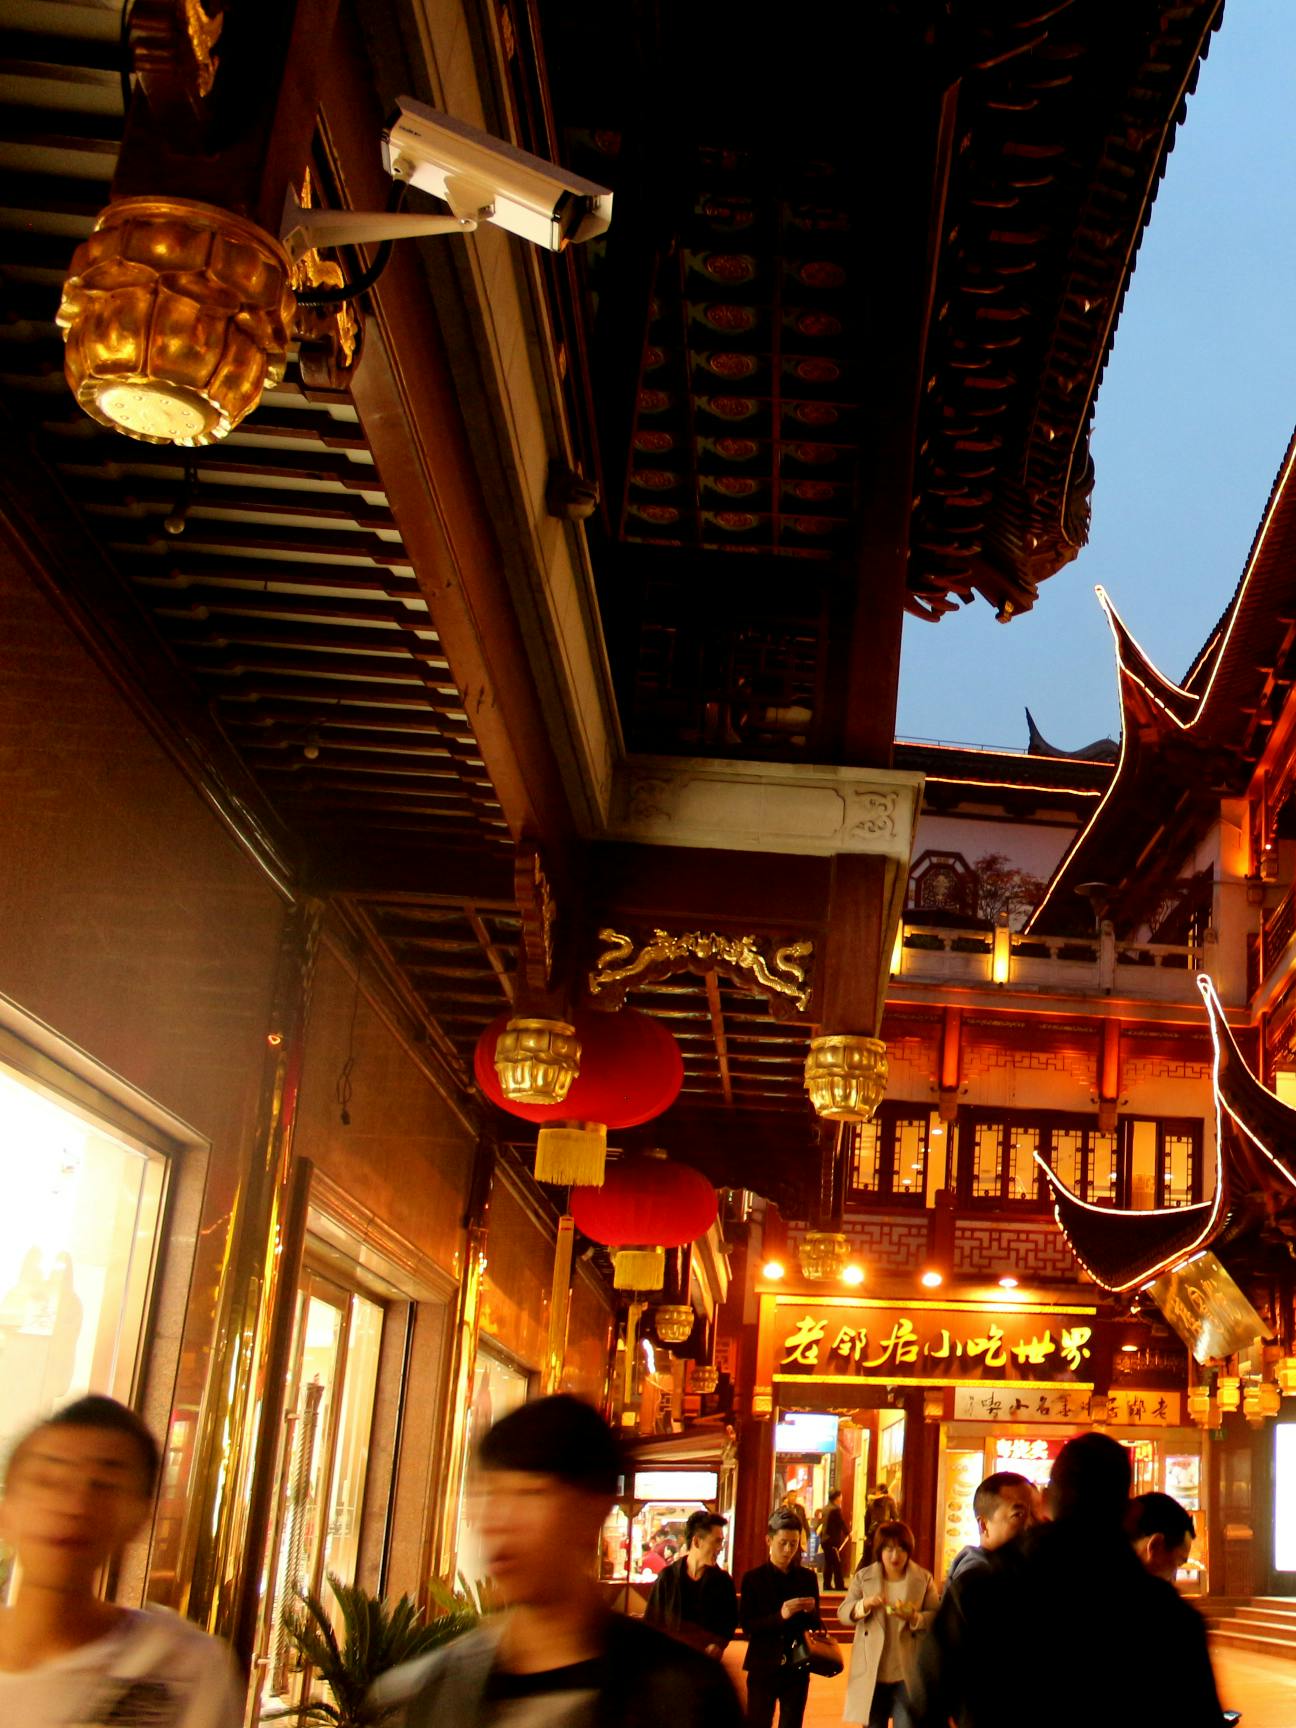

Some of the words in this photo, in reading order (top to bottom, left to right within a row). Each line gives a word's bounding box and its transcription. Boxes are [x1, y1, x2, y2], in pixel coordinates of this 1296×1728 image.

[780, 1315, 1093, 1371] 老邻居小吃世界
